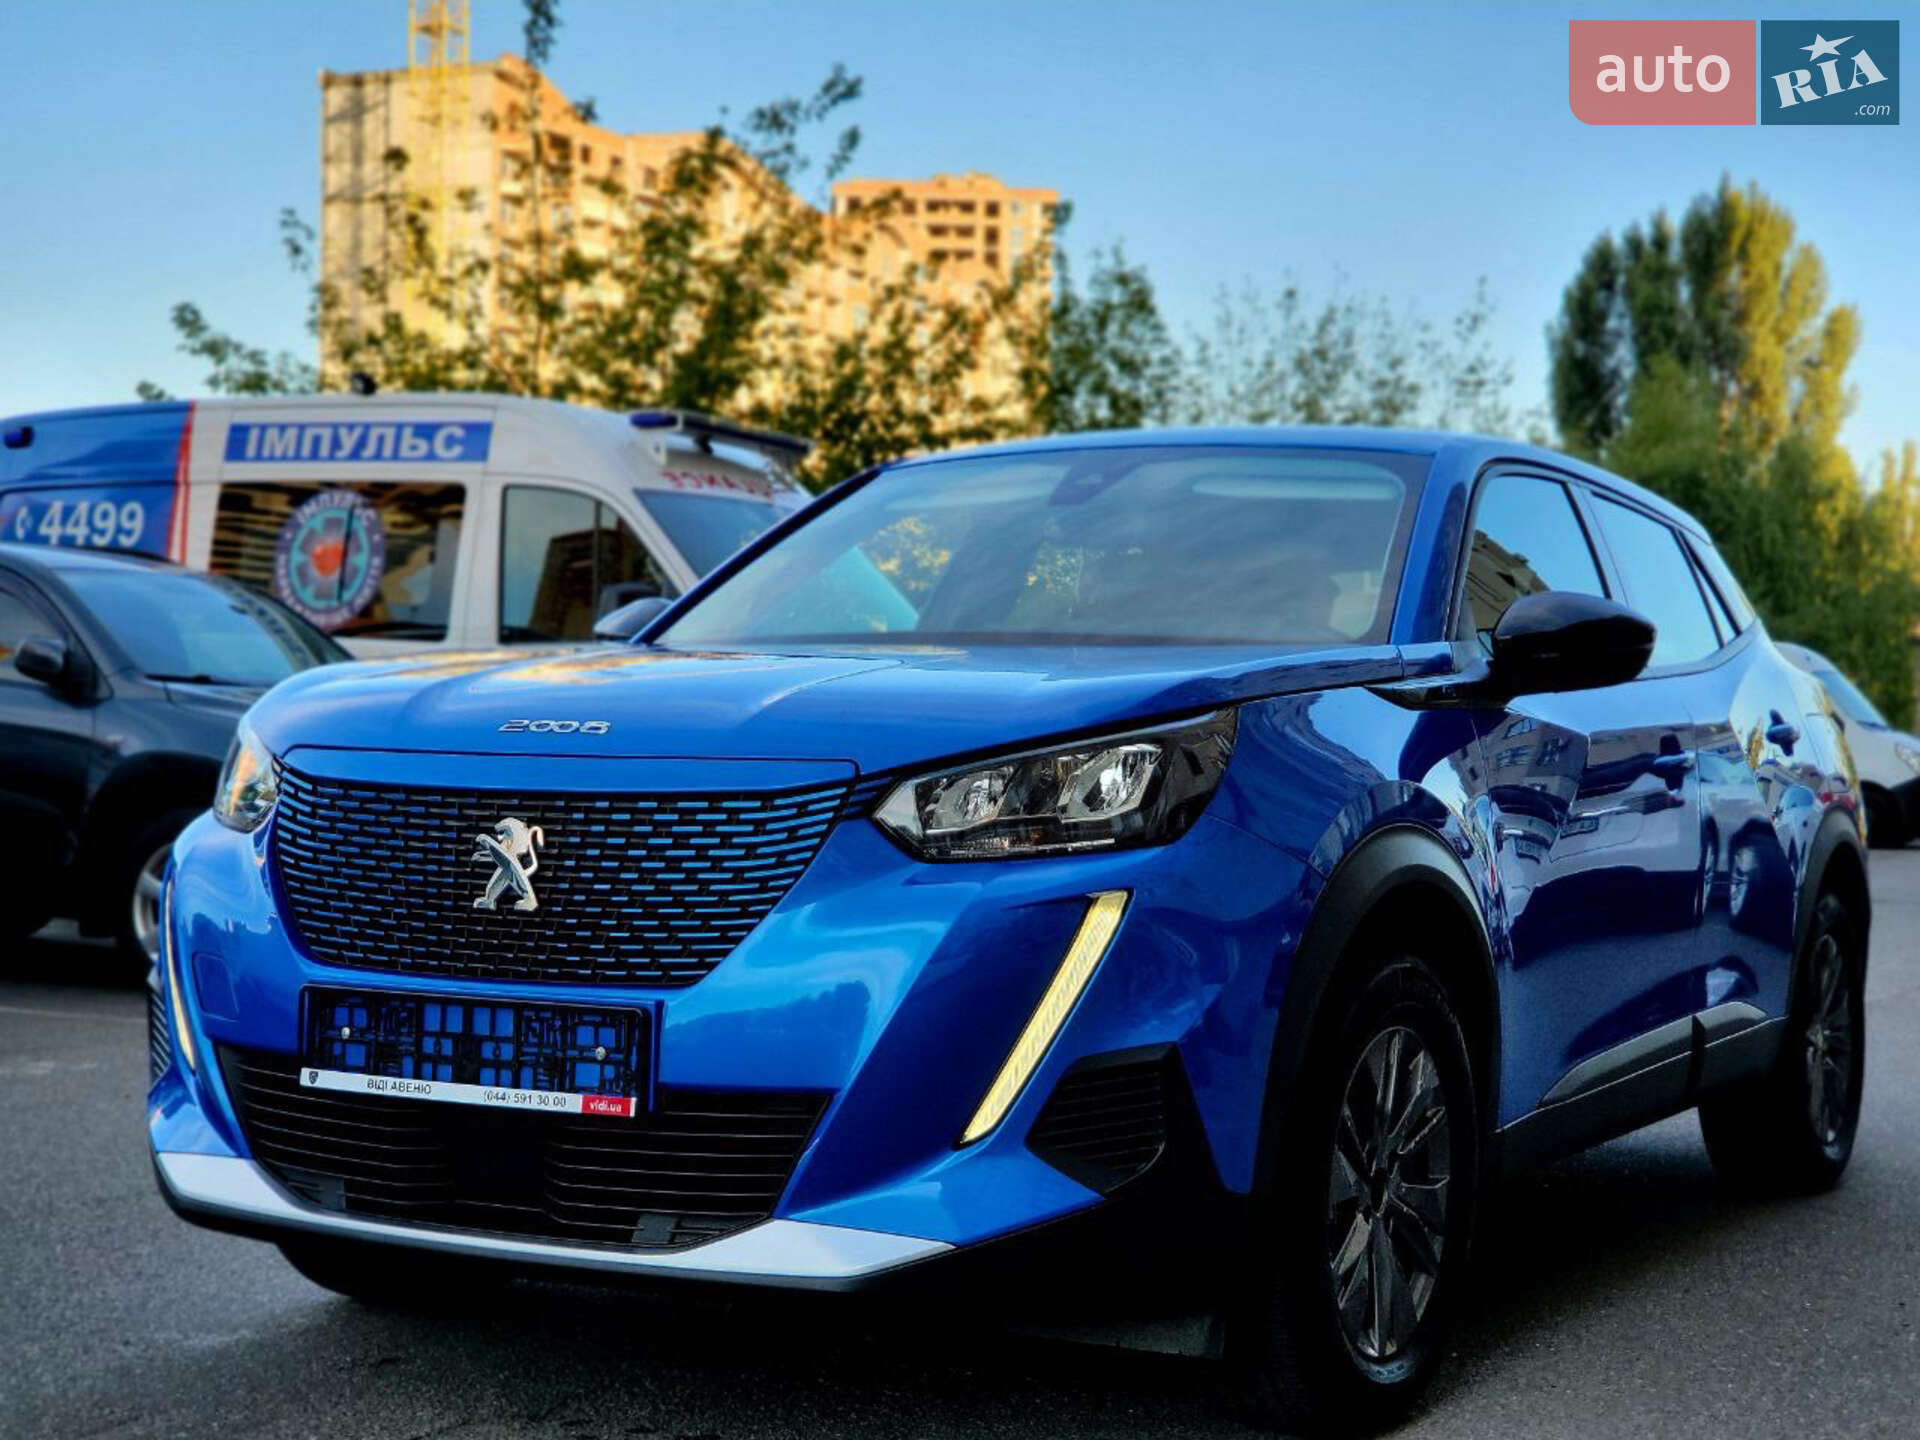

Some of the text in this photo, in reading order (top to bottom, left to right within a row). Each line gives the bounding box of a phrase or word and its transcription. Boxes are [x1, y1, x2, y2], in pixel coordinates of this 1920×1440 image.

[244, 424, 466, 459] ІМПУЛЬС
[38, 501, 145, 547] 4499
[498, 719, 611, 734] 2008
[390, 1081, 432, 1095] АВЕНЮ
[513, 1092, 533, 1105] 591
[536, 1094, 550, 1107] 30
[552, 1096, 567, 1108] 00
[588, 1100, 623, 1113] vidi.ua
